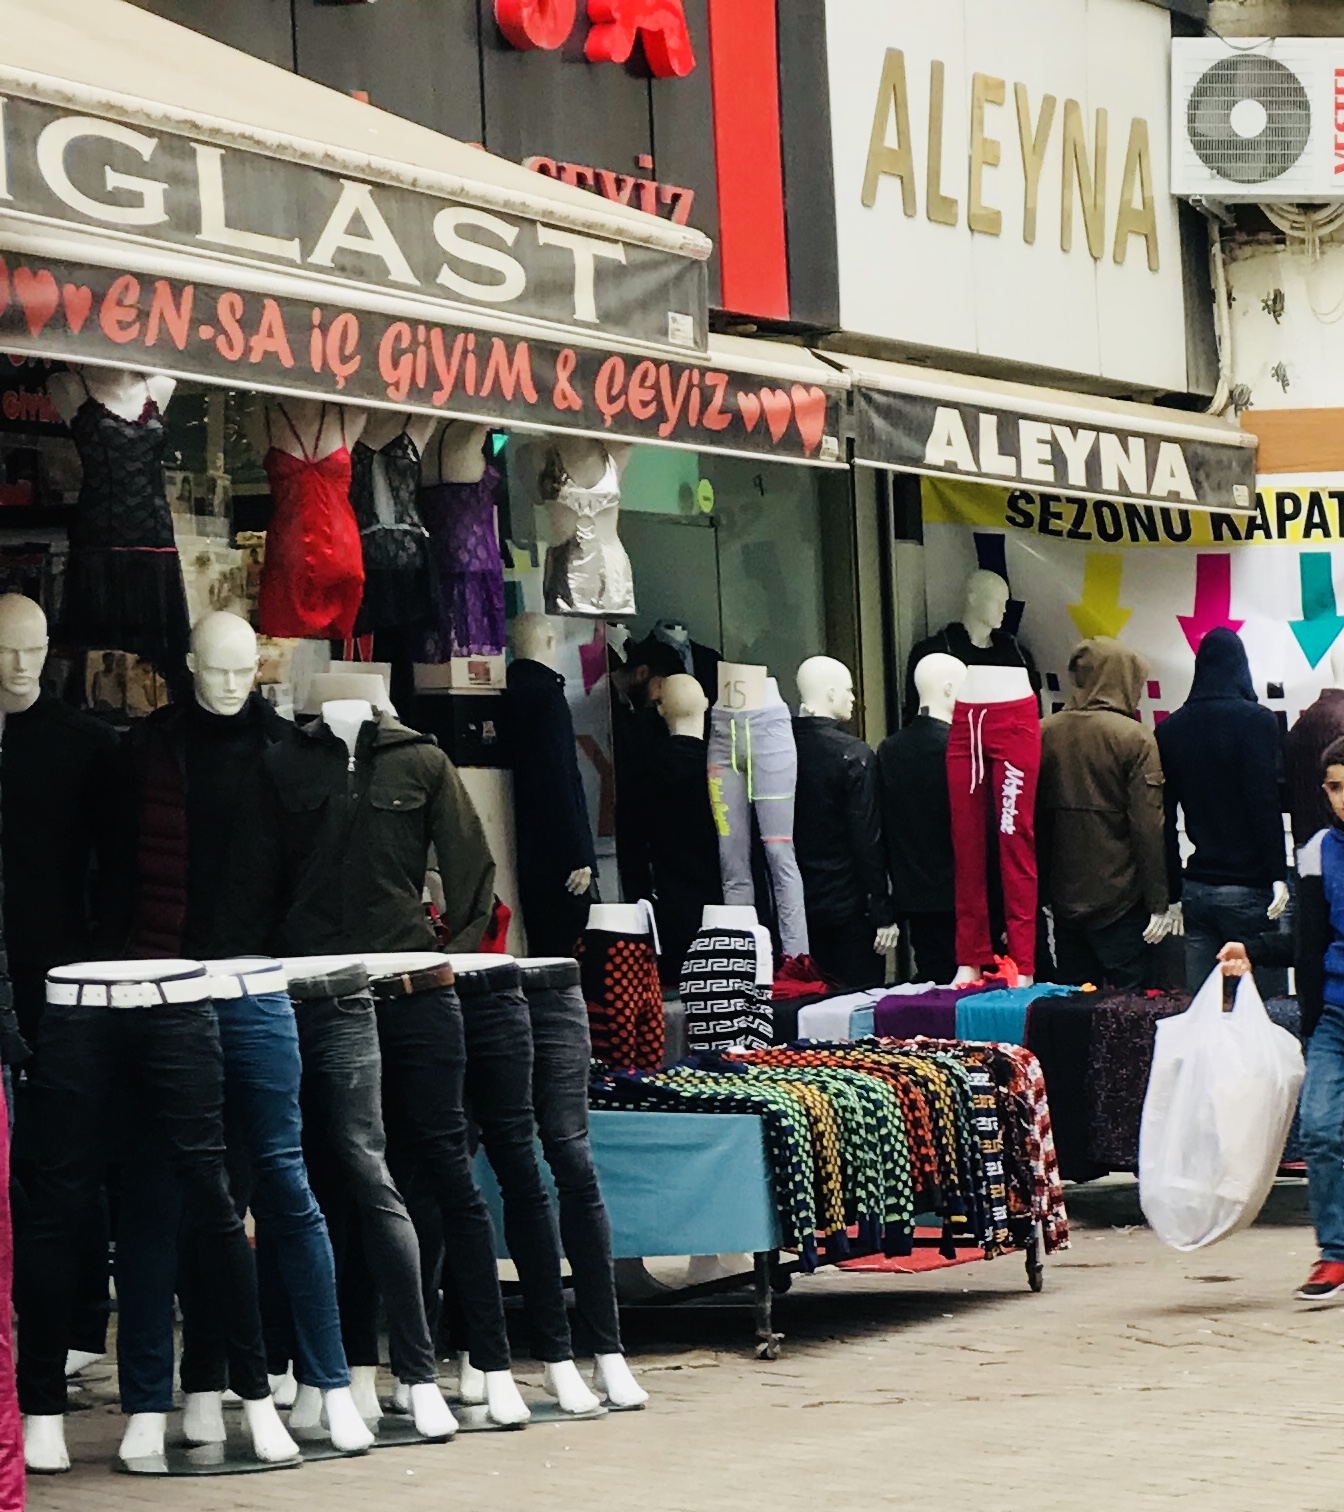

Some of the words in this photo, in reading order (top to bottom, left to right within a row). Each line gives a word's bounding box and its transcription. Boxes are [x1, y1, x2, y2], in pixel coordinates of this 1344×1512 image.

[861, 47, 1160, 272] ALEYNA
[100, 274, 294, 368] EN-SA
[309, 306, 362, 389] İÇ
[552, 348, 583, 411] &
[594, 355, 733, 438] ÇEYİZ
[924, 406, 1198, 501] ALEYNA
[1004, 487, 1191, 543] SEZONU
[722, 680, 747, 709] 15
